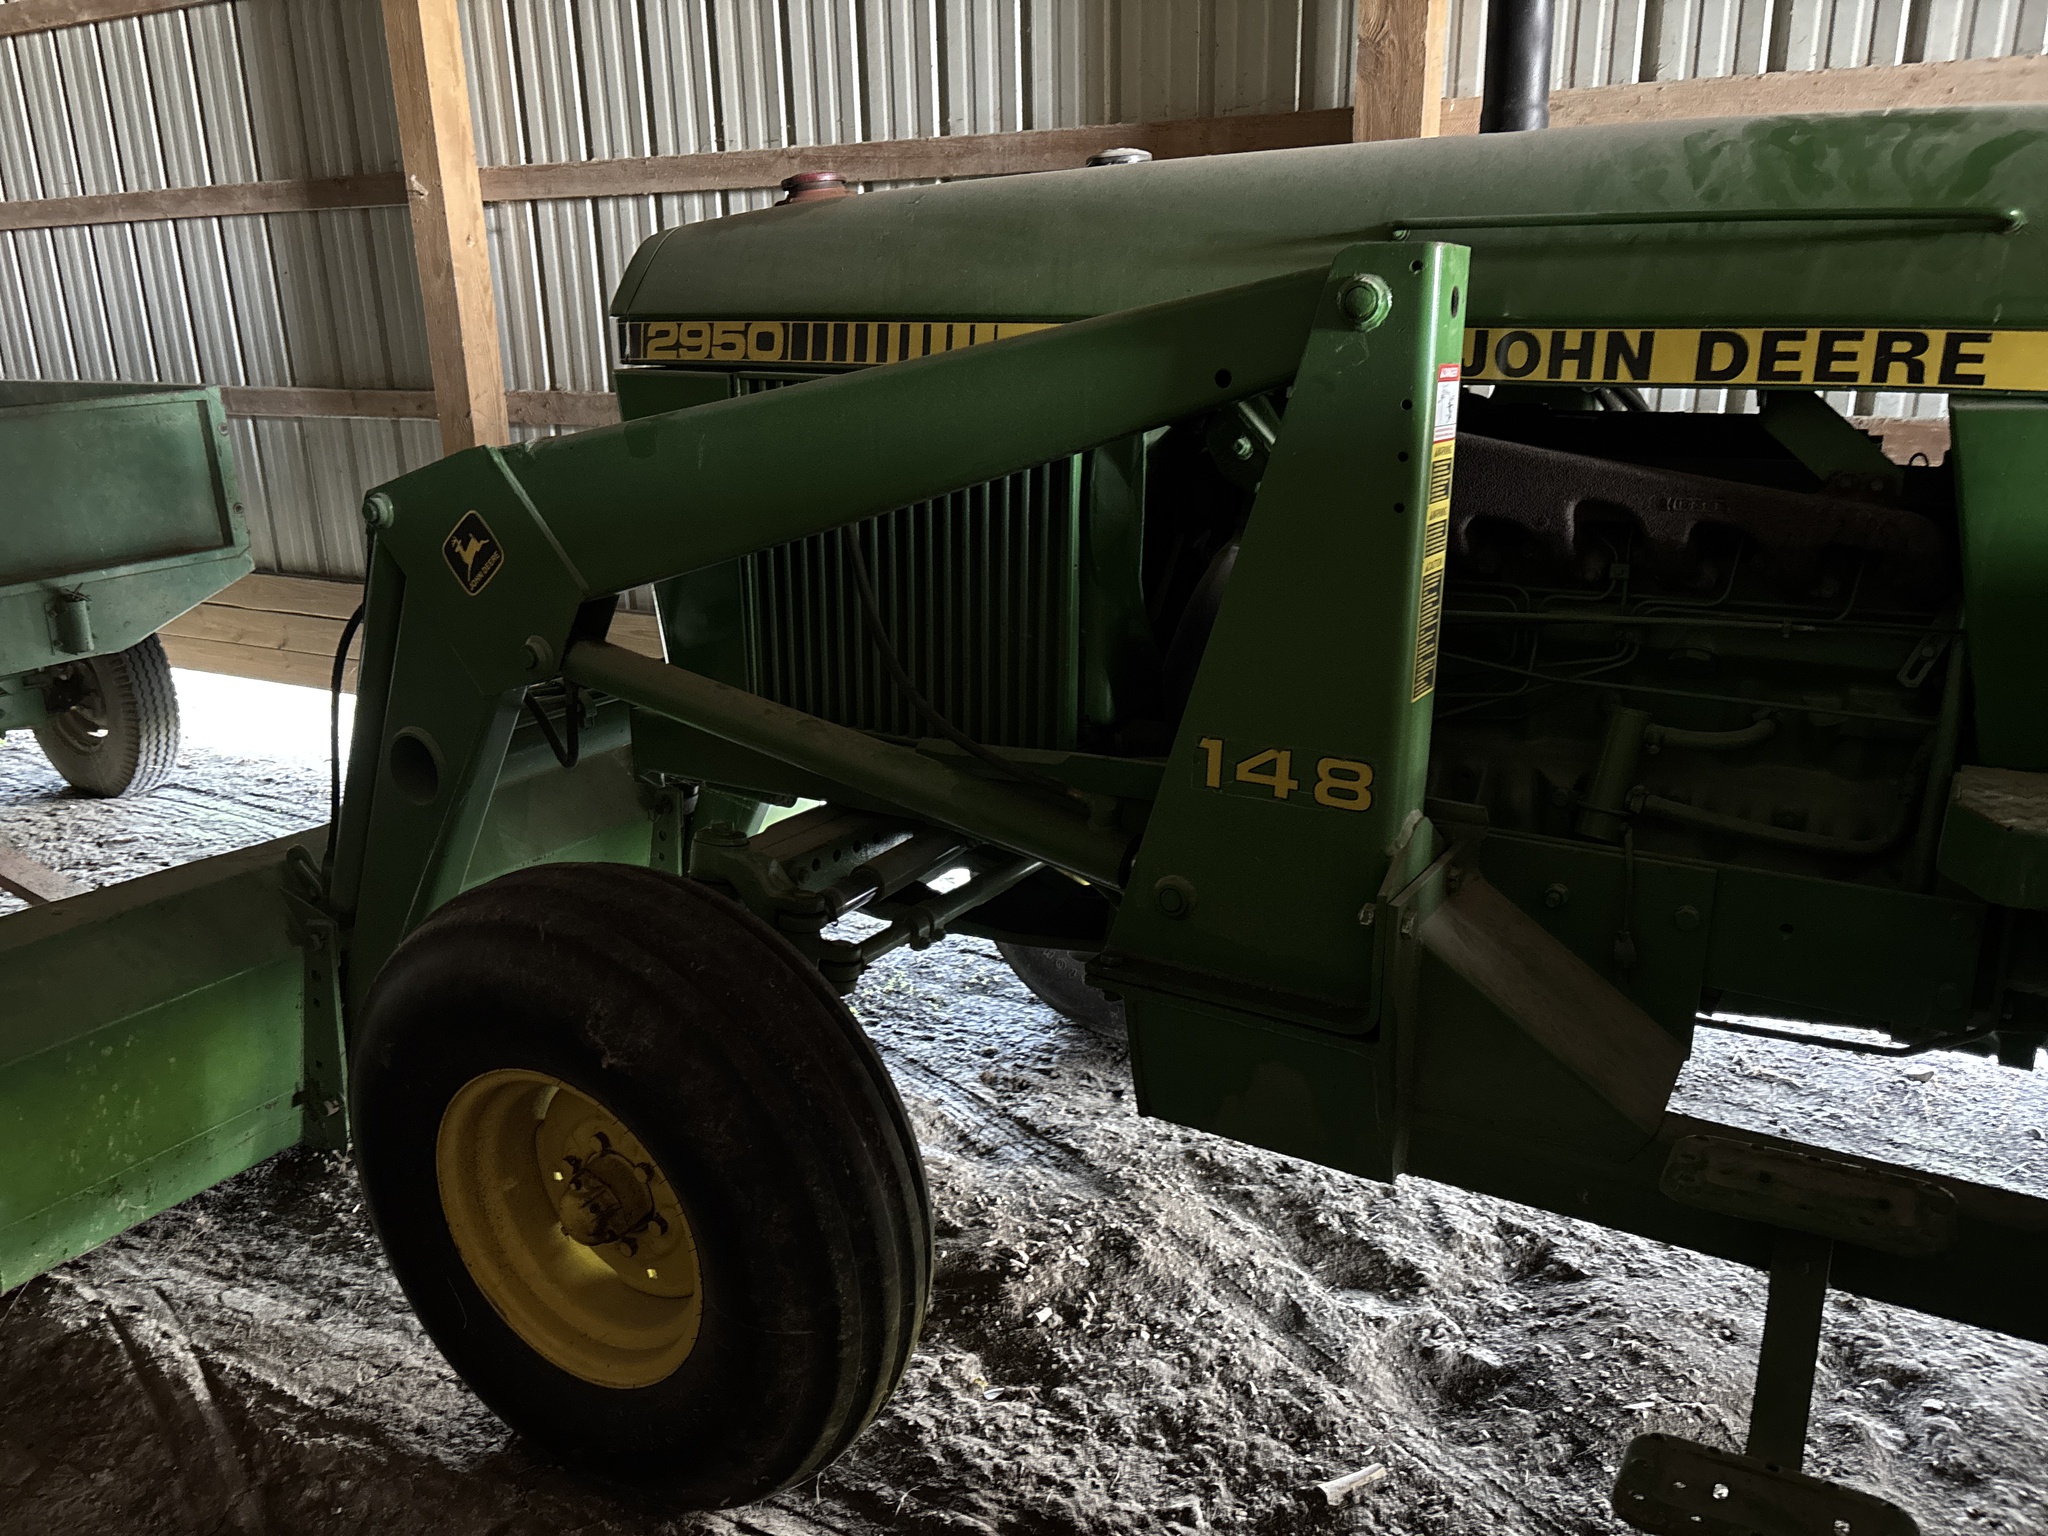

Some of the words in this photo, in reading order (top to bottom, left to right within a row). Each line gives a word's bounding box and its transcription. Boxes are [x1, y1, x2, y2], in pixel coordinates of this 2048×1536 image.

[647, 321, 785, 361] 2950
[1461, 329, 1656, 381] JOHN
[1694, 330, 1994, 386] DEERE
[1198, 737, 1375, 812] 148
